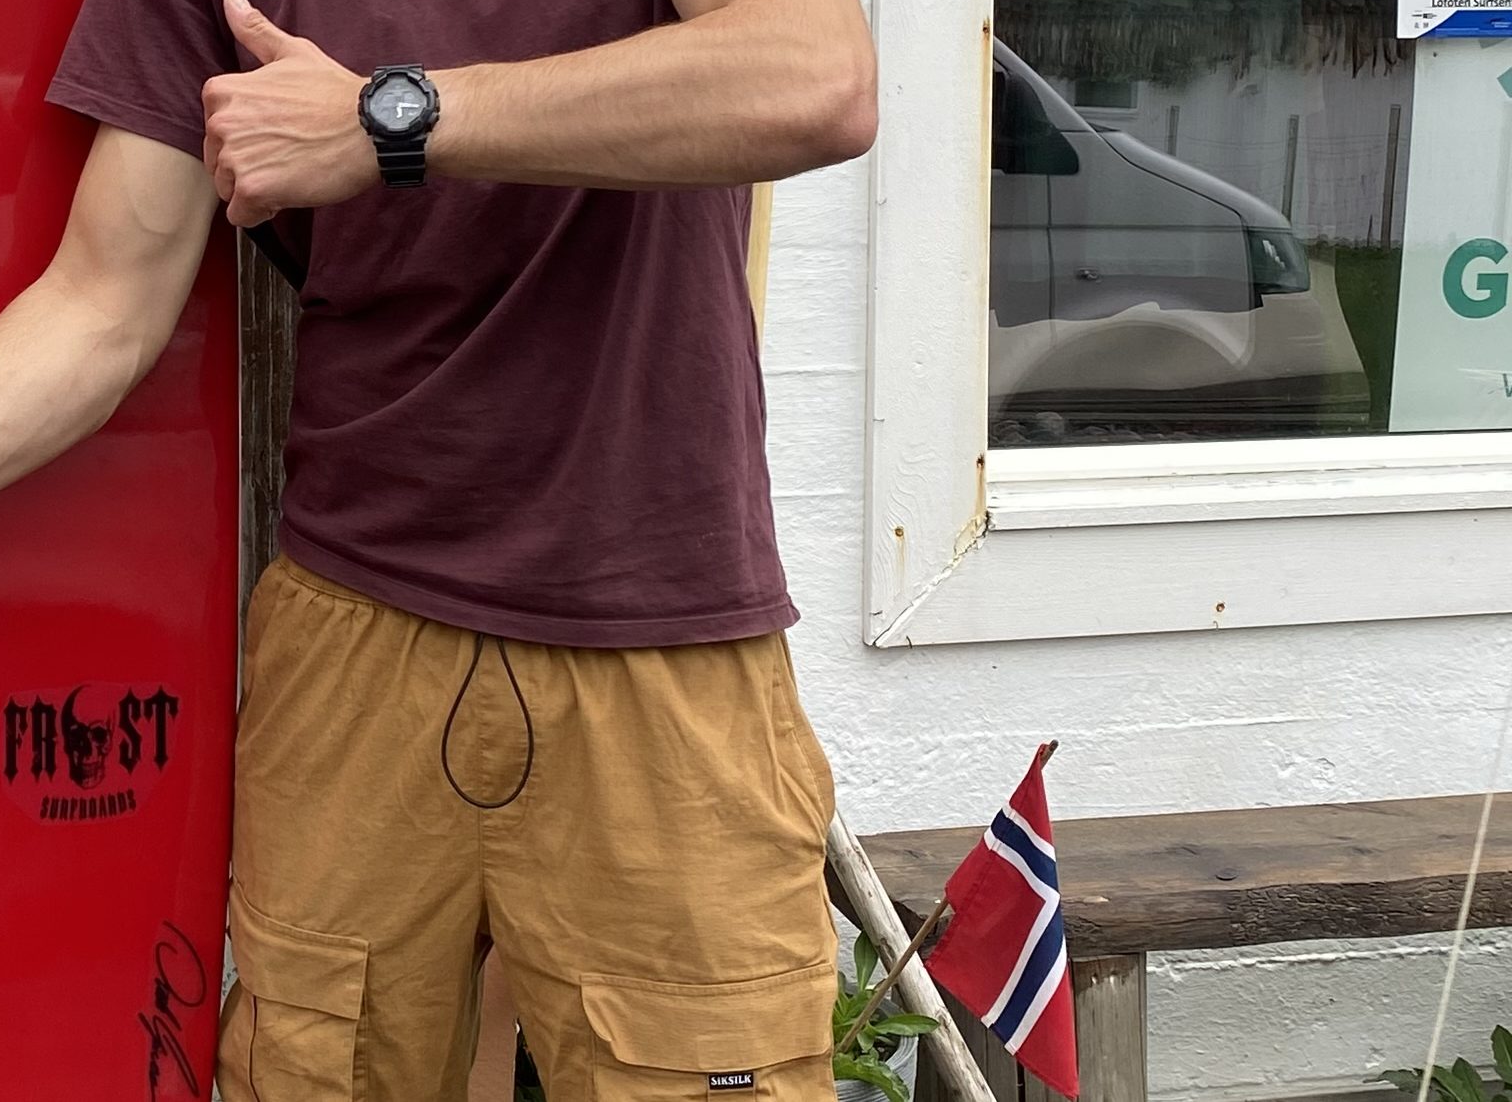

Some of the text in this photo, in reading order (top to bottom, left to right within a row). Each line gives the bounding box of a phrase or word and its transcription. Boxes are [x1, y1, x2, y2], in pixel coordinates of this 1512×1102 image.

[1442, 237, 1509, 319] G
[40, 789, 137, 821] SURFBOARDS
[710, 1074, 752, 1085] SIKSILK
